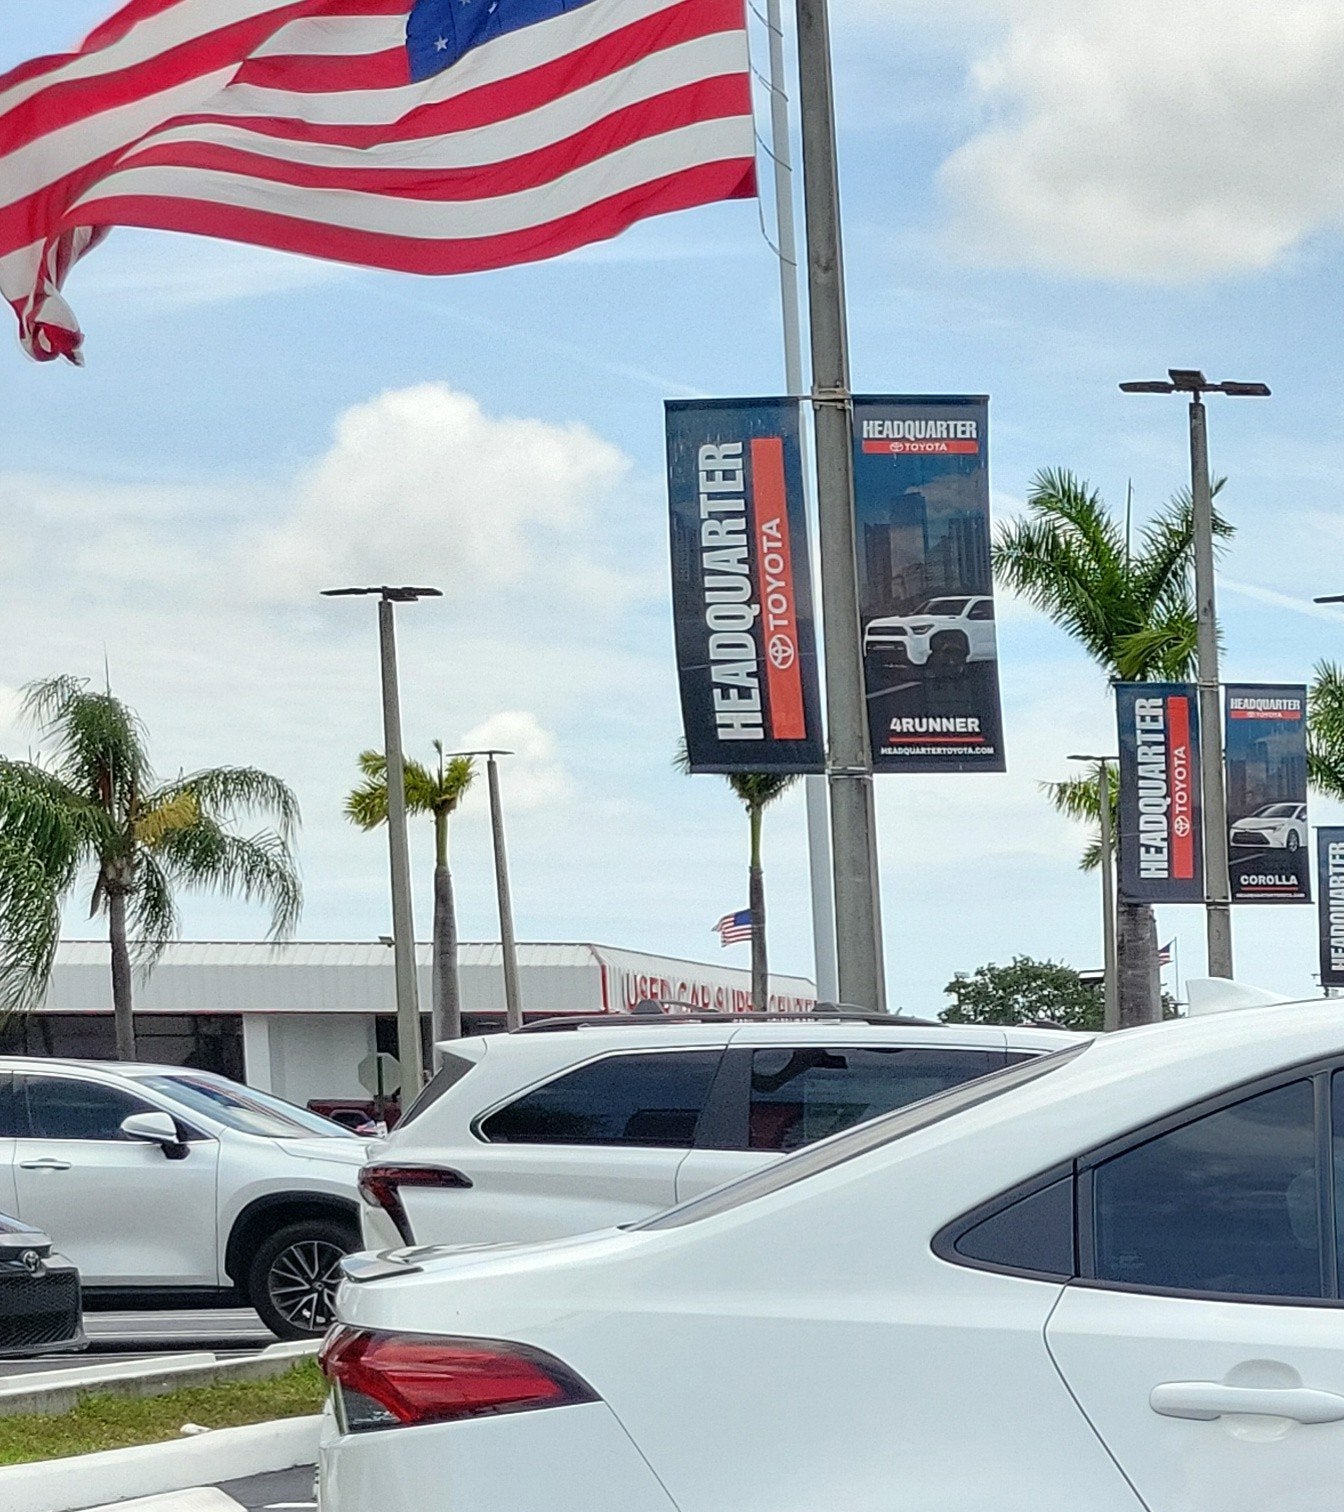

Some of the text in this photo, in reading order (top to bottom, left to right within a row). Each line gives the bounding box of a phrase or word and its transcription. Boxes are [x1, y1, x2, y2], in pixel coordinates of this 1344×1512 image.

[862, 419, 977, 441] HEADQUARTER
[904, 442, 948, 453] TOYOTA
[761, 517, 790, 632] TOYOTA
[699, 441, 767, 741] HEADQUARTER
[1230, 698, 1301, 711] HEADQUARTER
[889, 717, 981, 733] 4RUNNER
[1134, 697, 1170, 880] HEADQUARTER
[1172, 746, 1188, 814] TOYOTA
[1240, 875, 1298, 886] COROLLA
[626, 973, 671, 1013] USED
